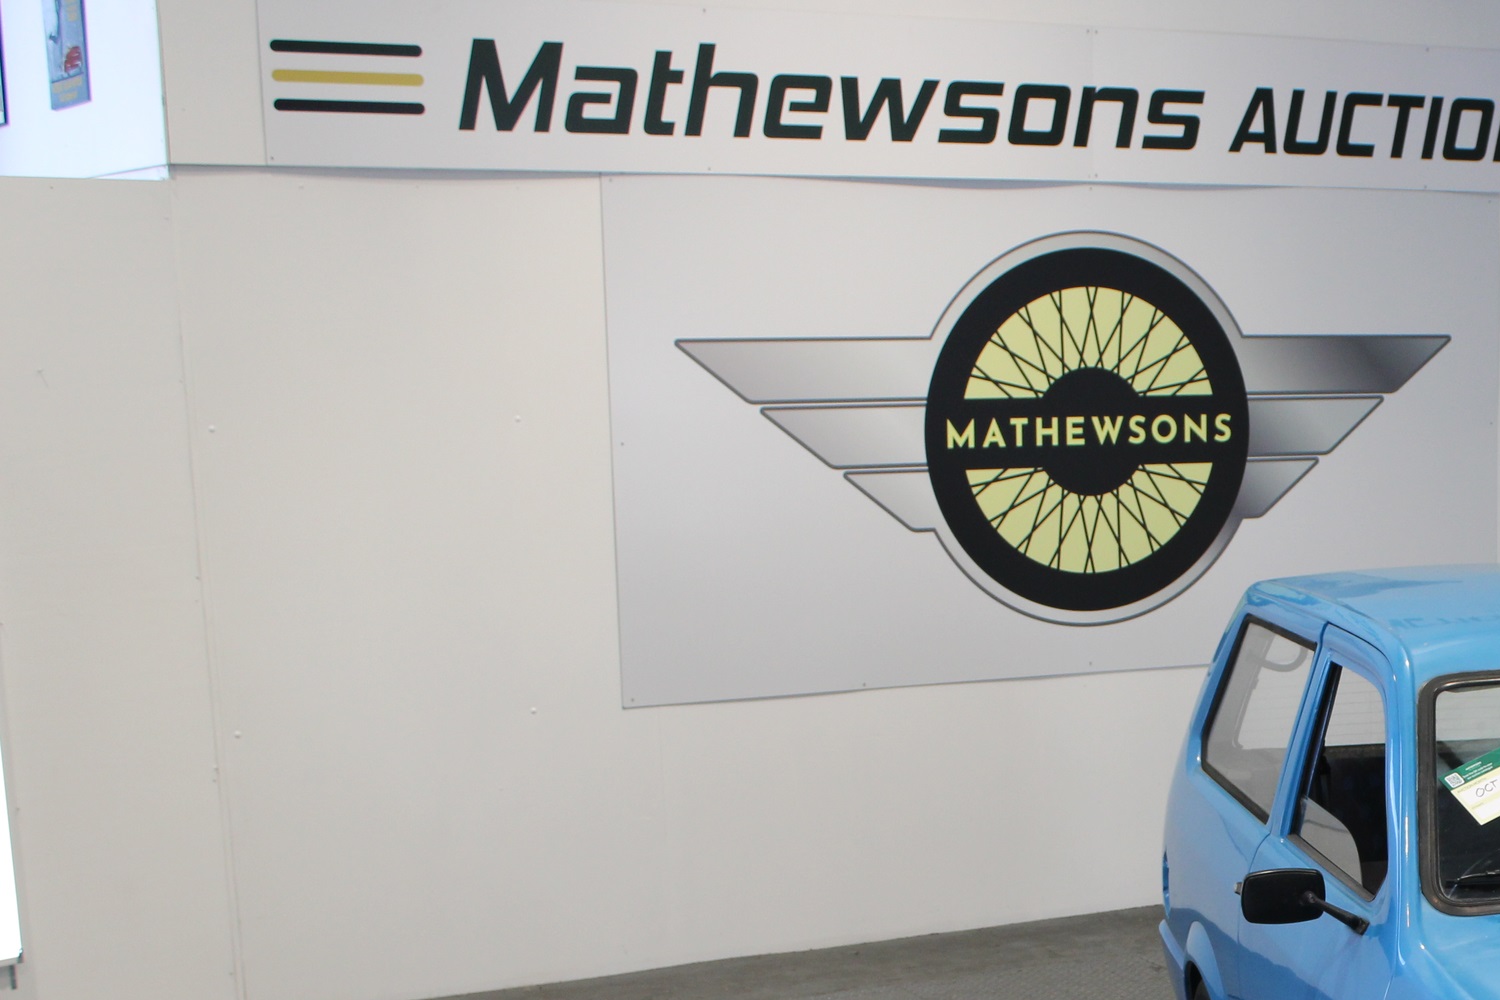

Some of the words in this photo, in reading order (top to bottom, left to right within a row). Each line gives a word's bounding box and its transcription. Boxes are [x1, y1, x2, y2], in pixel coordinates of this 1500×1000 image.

[458, 38, 1205, 150] Mathewsons
[946, 413, 1232, 449] MATHEWSONS
[1475, 779, 1498, 797] OCT
